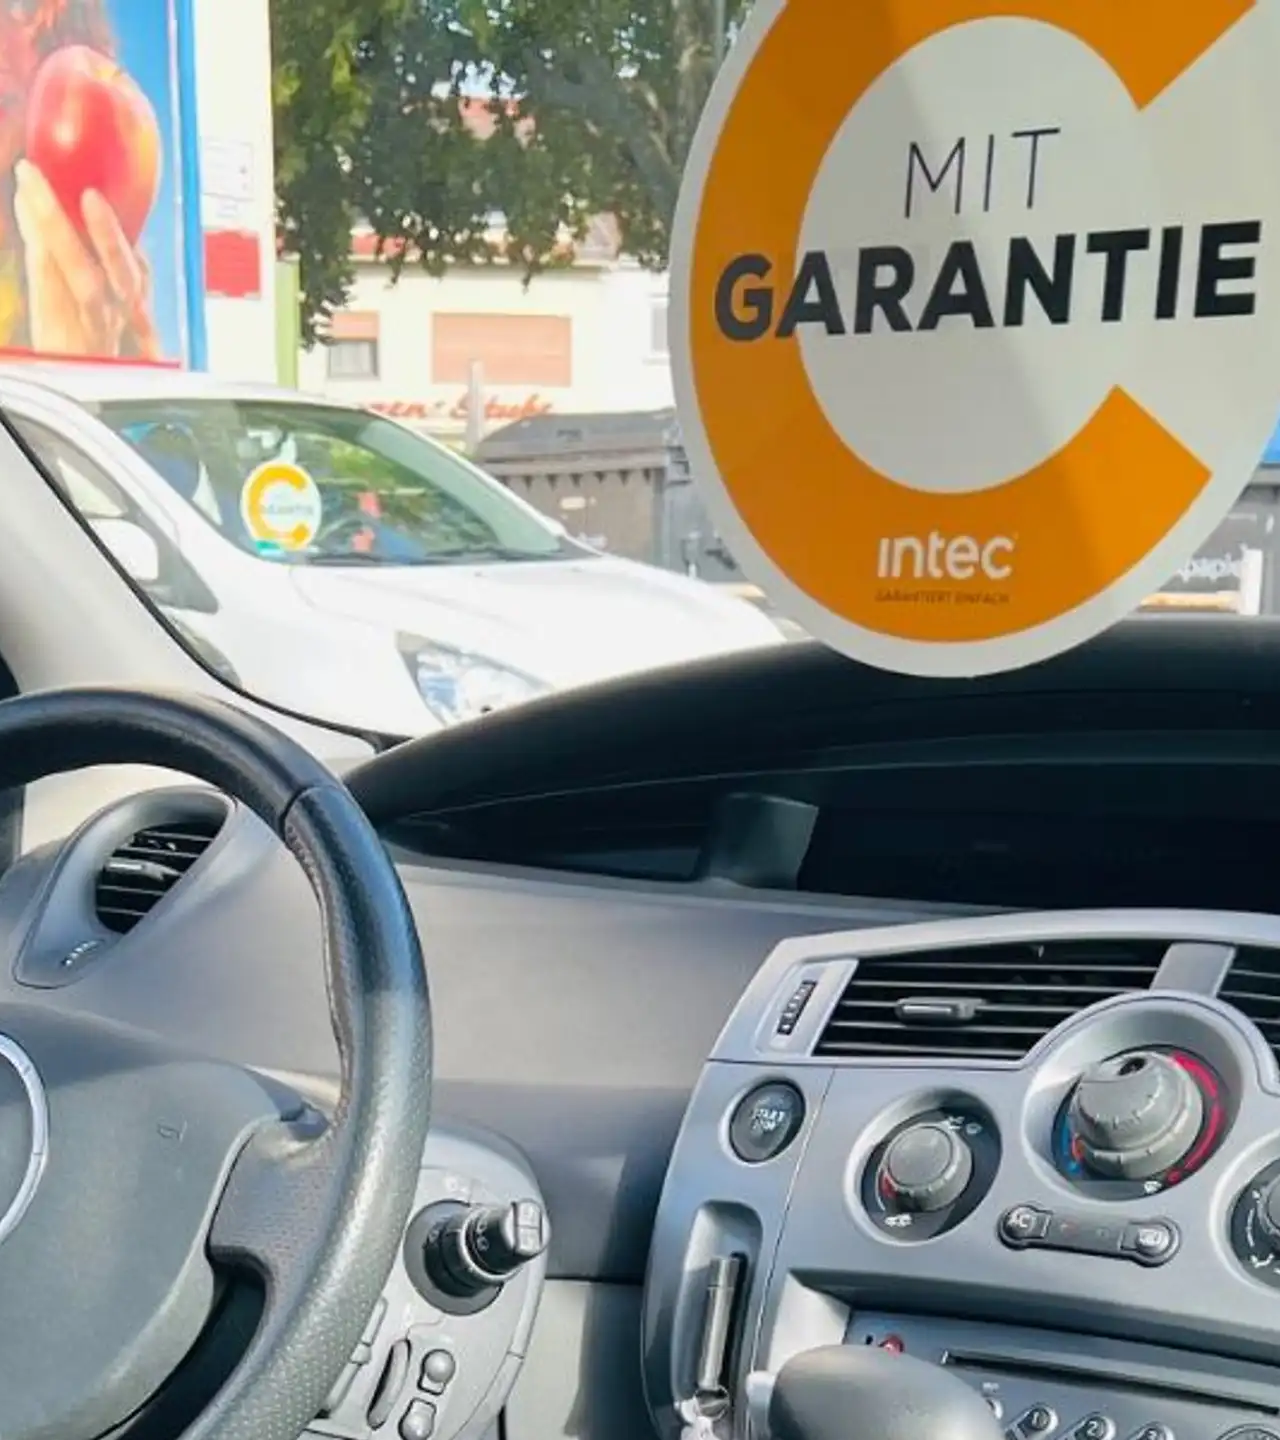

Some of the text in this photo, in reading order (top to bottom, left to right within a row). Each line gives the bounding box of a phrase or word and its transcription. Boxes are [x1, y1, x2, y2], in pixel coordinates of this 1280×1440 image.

[905, 127, 1061, 218] MIT
[715, 220, 1262, 342] GARANTIE
[877, 530, 1015, 581] intec
[1086, 1420, 1099, 1437] 2
